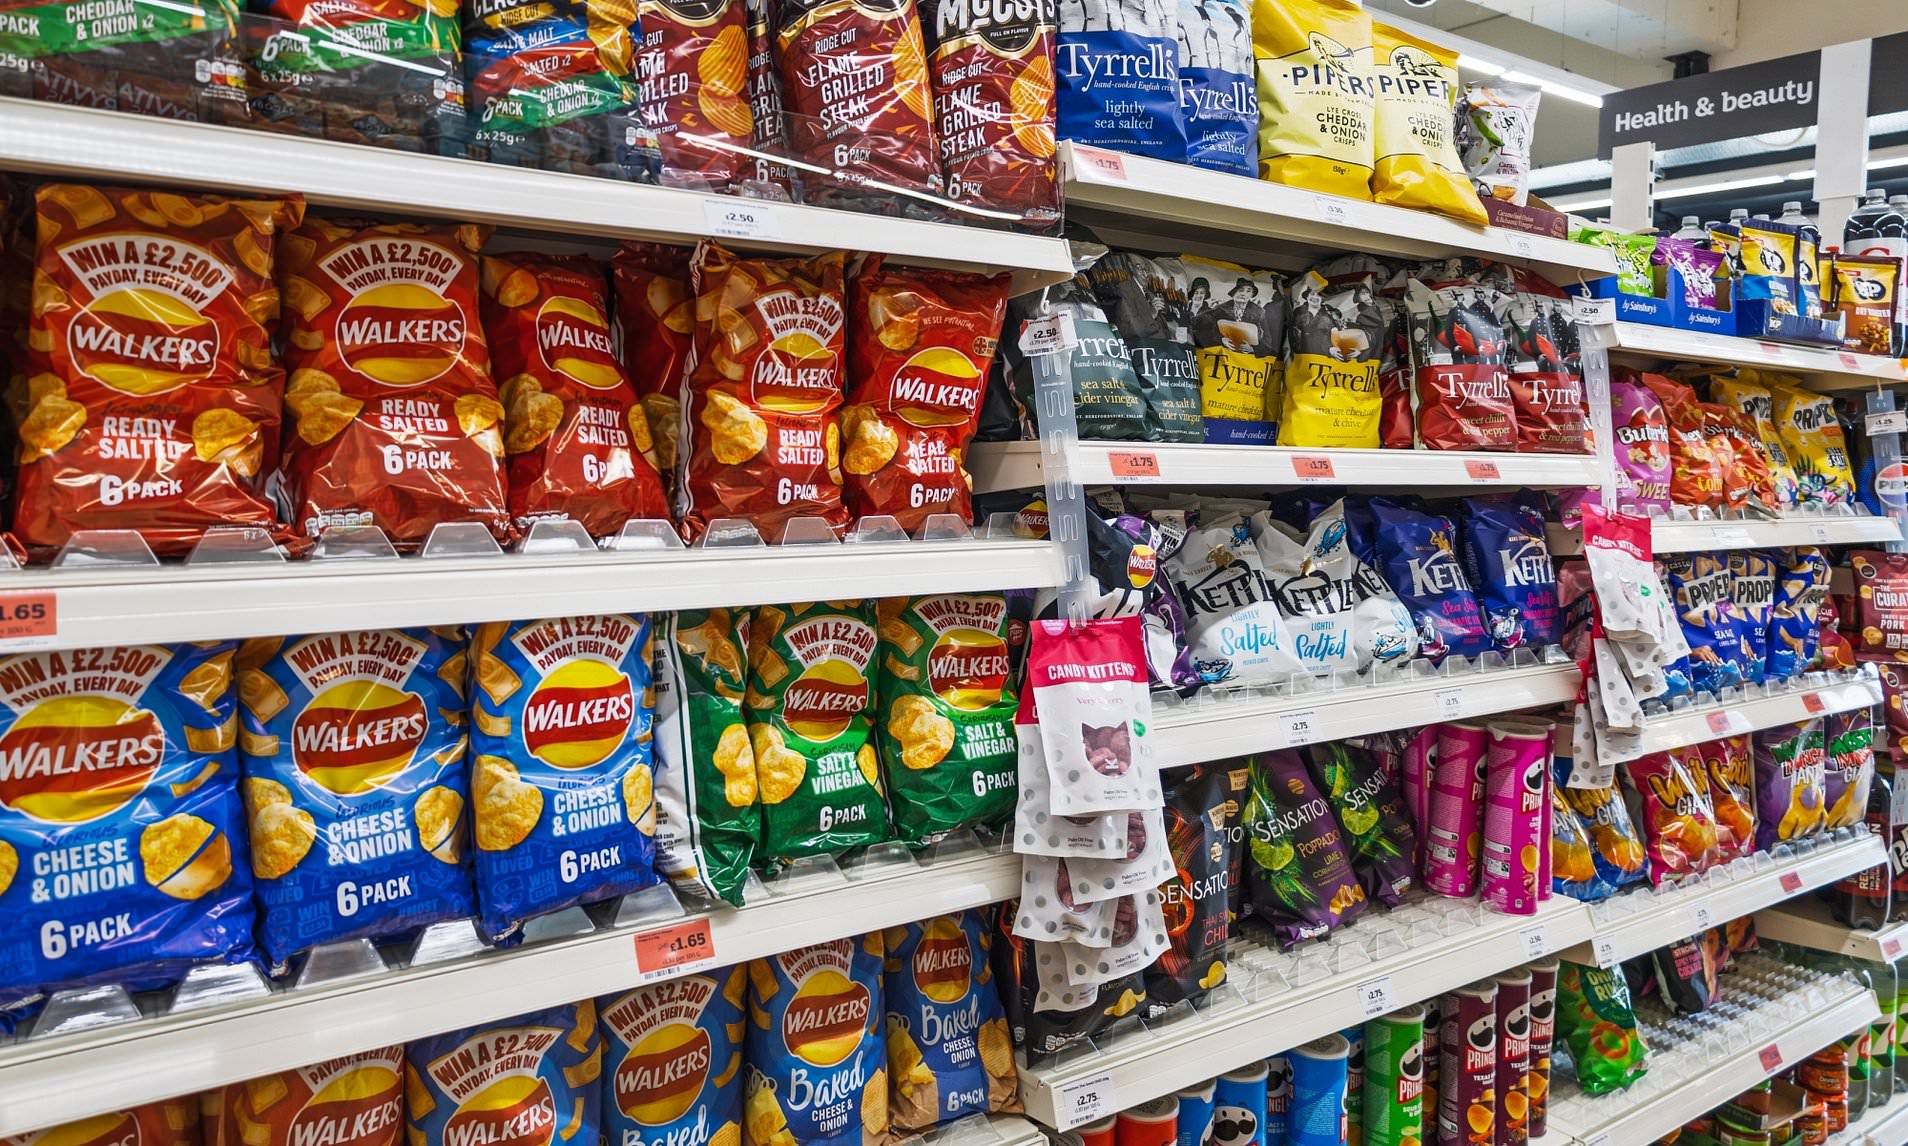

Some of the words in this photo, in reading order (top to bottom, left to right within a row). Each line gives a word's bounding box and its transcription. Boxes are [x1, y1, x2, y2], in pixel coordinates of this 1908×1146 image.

[76, 24, 88, 40] &
[92, 14, 138, 37] ONION
[647, 30, 663, 46] CUT
[261, 34, 279, 62] 6
[815, 33, 840, 54] RIDGE
[841, 27, 857, 46] CUT
[808, 50, 861, 82] FLAME
[942, 67, 966, 87] RIDGE
[967, 62, 983, 79] CUT
[821, 64, 884, 106] GRILLED
[1292, 64, 1375, 98] PIPERS
[496, 100, 523, 116] PACK
[546, 105, 555, 117] &
[557, 94, 589, 115] ONION
[934, 84, 982, 118] FLAME
[1105, 100, 1145, 117] lightly
[1615, 101, 1689, 132] Health
[1695, 96, 1714, 117] &
[1721, 79, 1813, 114] beauty
[943, 101, 1001, 137] GRILLED
[1094, 119, 1116, 130] sea
[1118, 116, 1154, 130] salted
[1316, 113, 1367, 132] CHEDDAR
[941, 126, 987, 160] STEAK
[1319, 124, 1328, 133] &
[1330, 125, 1366, 142] ONION
[1333, 136, 1356, 147] CRISPS
[834, 144, 849, 167] 6
[848, 148, 871, 163] PACK
[1217, 142, 1245, 156] salted
[947, 173, 961, 199] 6
[962, 182, 982, 197] PACK
[1622, 301, 1630, 313] by
[1630, 300, 1657, 315] Sainsbury's
[1688, 313, 1695, 325] by
[1695, 313, 1722, 326] Sainsbury's
[340, 316, 463, 345] WALKERS
[1033, 328, 1057, 339] £2.50
[74, 324, 214, 366] WALKERS
[757, 361, 835, 390] WALKERS
[1080, 380, 1099, 390] sea
[895, 377, 980, 410] WALKERS
[1103, 392, 1139, 408] vinegar
[1162, 399, 1175, 408] sea
[1176, 398, 1189, 408] salt
[1190, 398, 1197, 408] &
[1207, 398, 1238, 412] mature
[381, 399, 440, 418] READY
[579, 404, 620, 428] READY
[1158, 410, 1178, 420] cider
[1315, 405, 1344, 416] mature
[1484, 413, 1505, 423] chilli
[103, 416, 177, 438] READY
[378, 415, 449, 432] SALTED
[1332, 418, 1340, 427] &
[1341, 418, 1361, 429] chive
[1481, 426, 1510, 438] pepper
[577, 425, 629, 448] SALTED
[779, 430, 822, 448] READY
[98, 438, 184, 461] SALTED
[382, 444, 404, 475] 6
[406, 449, 452, 470] PACK
[778, 447, 824, 465] SALTED
[582, 453, 599, 483] 6
[1130, 457, 1153, 468] £1.75
[100, 475, 123, 506] 6
[127, 480, 183, 501] PACK
[777, 477, 791, 505] 6
[910, 483, 924, 508] 6
[1311, 620, 1335, 631] LIGHTLY
[1880, 619, 1905, 629] PORK
[522, 627, 561, 657] WIN
[561, 618, 574, 638] A
[1220, 620, 1280, 656] Salted
[1296, 629, 1346, 662] Salted
[577, 639, 605, 656] EVERY
[605, 645, 624, 662] DAY
[930, 655, 1010, 679] WALKERS
[1048, 665, 1086, 680] CANDY
[1087, 663, 1134, 679] KITTENS
[786, 689, 867, 713] WALKERS
[526, 697, 631, 733] WALKERS
[297, 713, 424, 753] WALKERS
[965, 722, 995, 742] SALT
[996, 722, 1006, 737] &
[0, 735, 159, 782] WALKERS
[961, 737, 1015, 760] VINEGAR
[816, 753, 848, 776] SALT
[849, 752, 857, 770] &
[971, 770, 986, 797] 6
[988, 770, 1015, 790] PACK
[554, 782, 616, 815] CHEESE
[328, 807, 406, 841] CHEESE
[553, 816, 566, 837] &
[568, 803, 622, 832] ONION
[819, 805, 833, 832] 6
[833, 803, 867, 825] PACK
[1253, 798, 1329, 843] SENSATION
[33, 837, 129, 876] CHEESE
[328, 843, 345, 866] &
[347, 829, 412, 863] ONION
[560, 850, 578, 884] 6
[580, 846, 621, 875] PACK
[31, 879, 51, 903] &
[54, 861, 136, 900] ONION
[336, 881, 358, 917] 6
[362, 876, 411, 906] PACK
[40, 919, 68, 960] 6
[70, 913, 133, 948] PACK
[669, 931, 706, 952] £1.65
[915, 946, 970, 974] WALKERS
[786, 996, 869, 1034] WALKERS
[920, 994, 980, 1045] Baked
[943, 1036, 972, 1053] CHEESE
[951, 1049, 976, 1064] ONION
[618, 1044, 708, 1094] WALKERS
[787, 1050, 864, 1111] Baked
[811, 1100, 846, 1122] CHEESE
[847, 1098, 854, 1110] &
[947, 1090, 960, 1112] 6
[960, 1088, 985, 1106] PACK
[1077, 1092, 1097, 1106] £2.75
[293, 1097, 400, 1146] WALKERS
[447, 1094, 553, 1146] WALKERS
[820, 1115, 848, 1132] ONION
